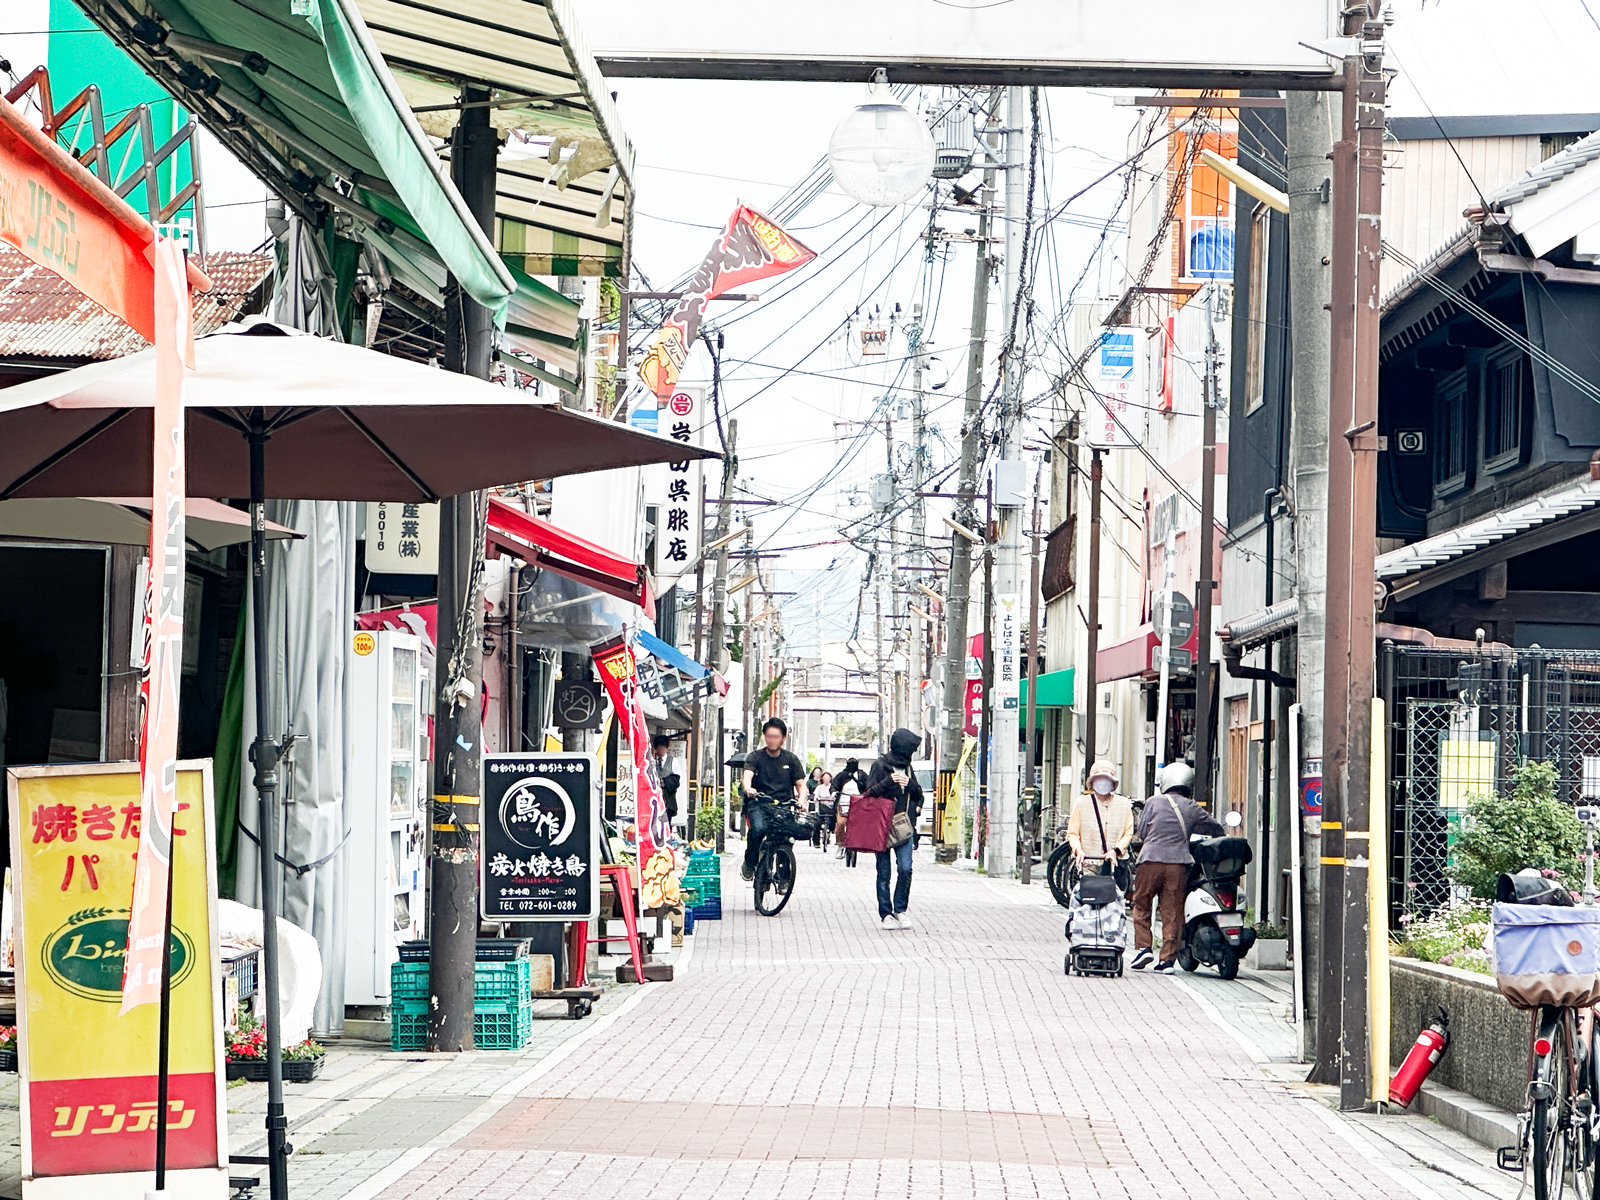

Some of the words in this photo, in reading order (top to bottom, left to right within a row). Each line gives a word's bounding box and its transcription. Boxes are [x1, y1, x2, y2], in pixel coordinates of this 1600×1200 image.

[1002, 613, 1013, 682] よしはら歯科医院
[511, 787, 560, 840] 鳥作
[488, 851, 588, 878] 炭火焼き鳥
[499, 900, 515, 911] TEL
[518, 900, 578, 911] 072-601-0289
[51, 1099, 196, 1138] リンデン
